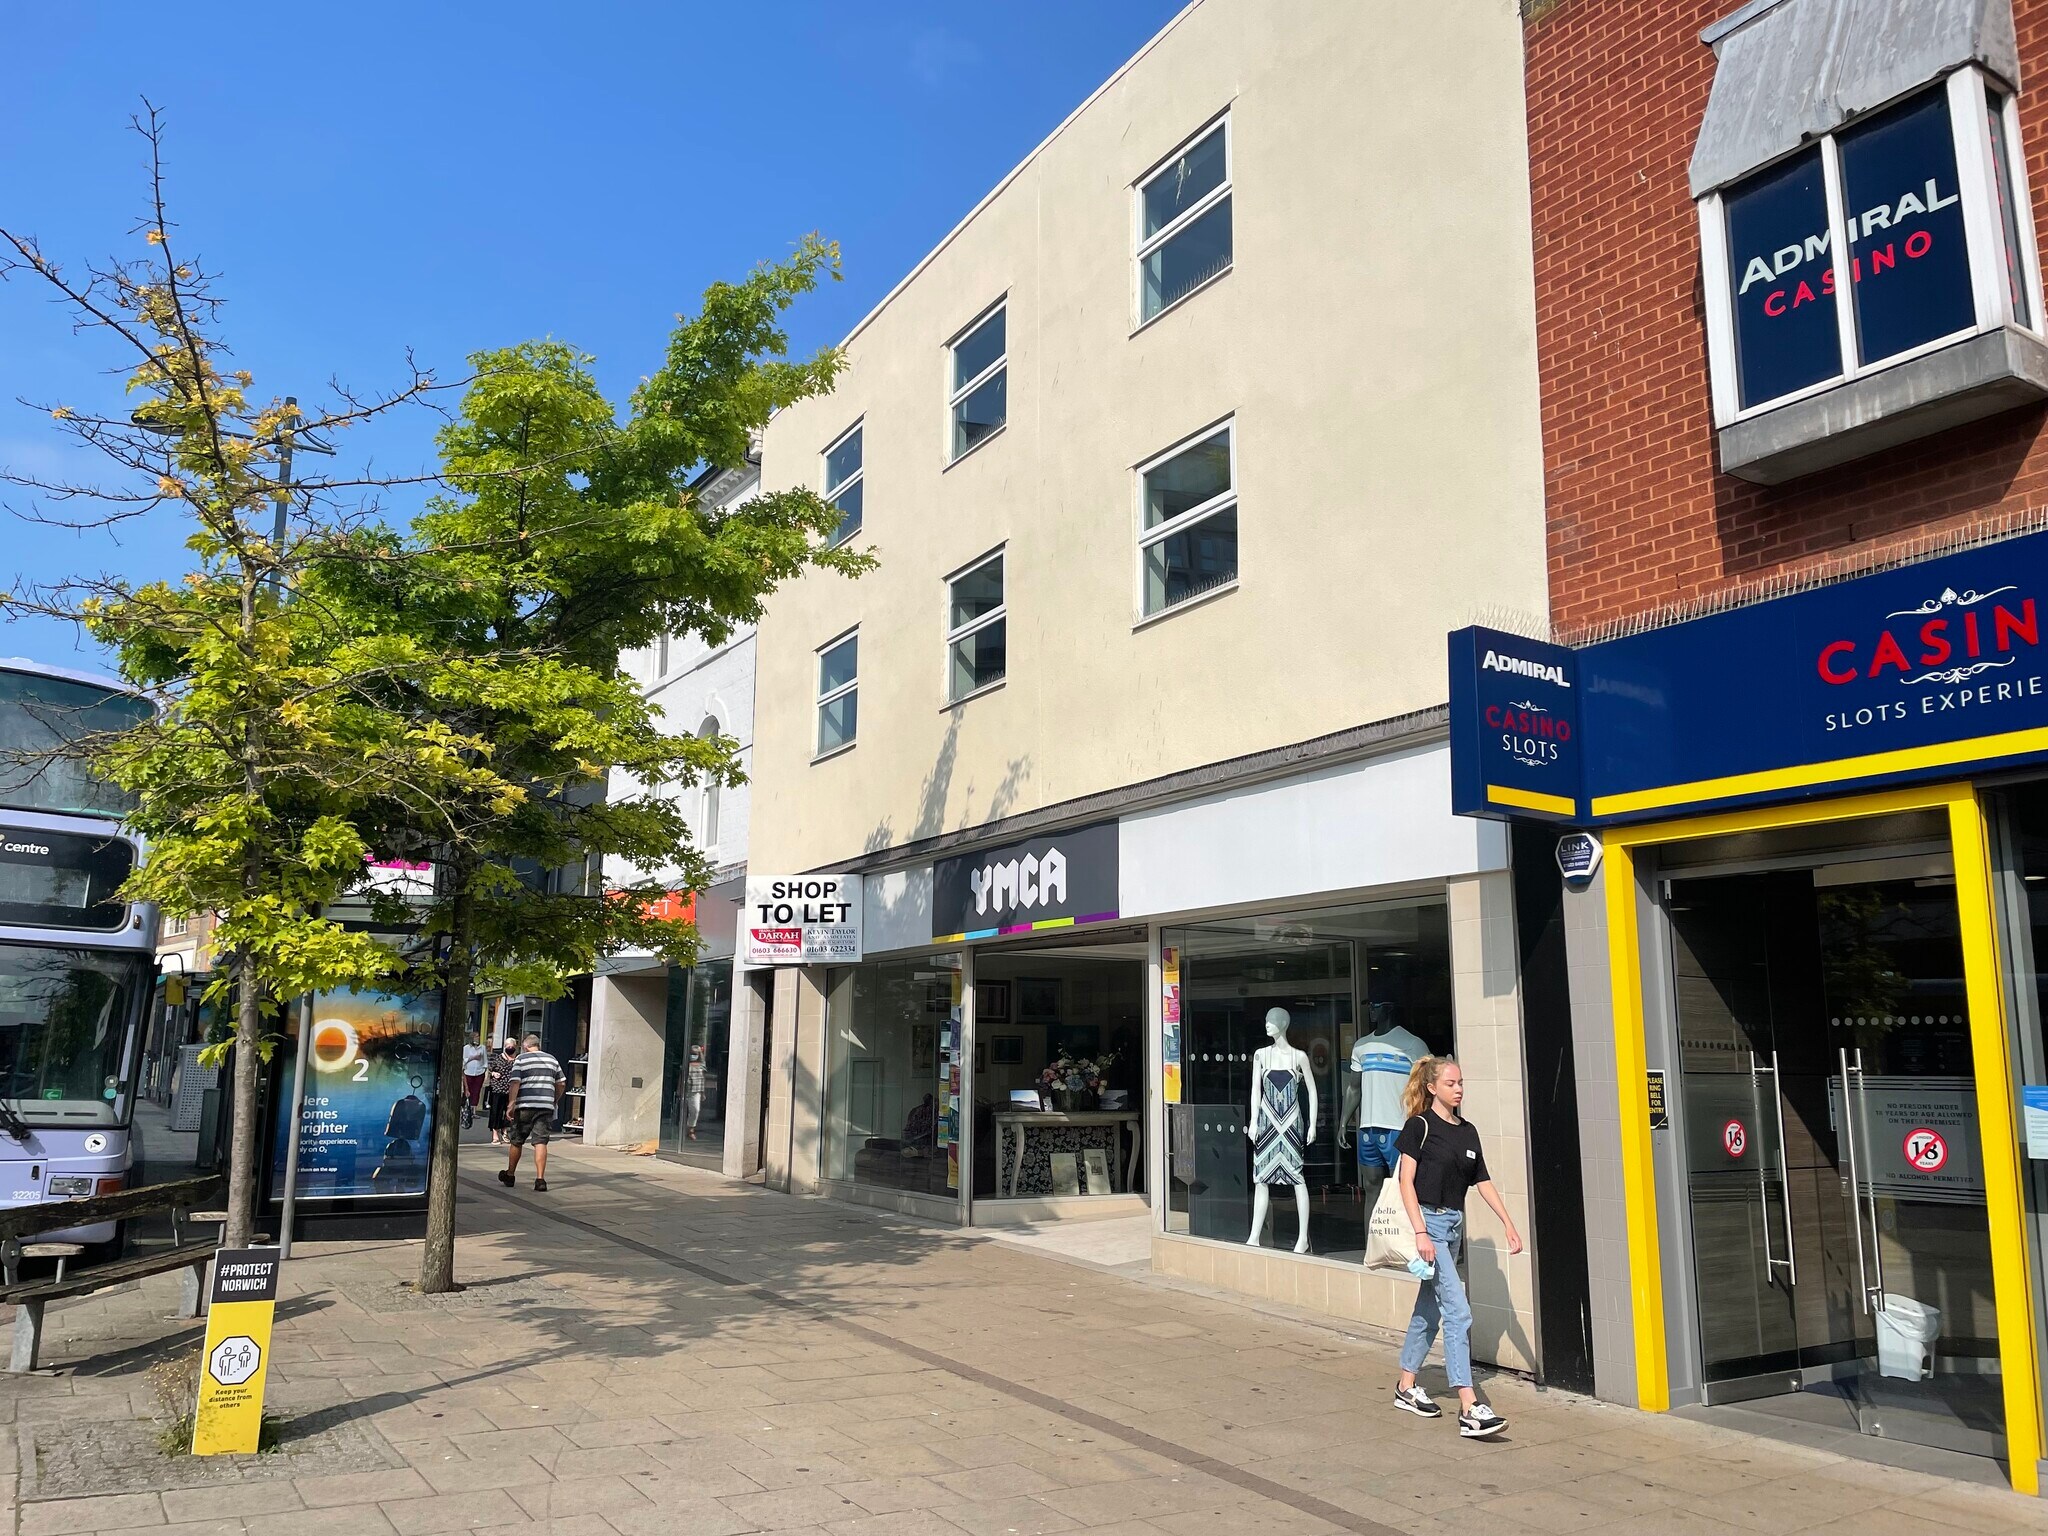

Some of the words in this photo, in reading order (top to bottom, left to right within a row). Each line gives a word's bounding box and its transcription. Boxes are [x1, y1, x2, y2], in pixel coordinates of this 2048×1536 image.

[1738, 178, 1958, 295] ADMIRAL
[1764, 231, 1932, 316] CASINO
[1817, 598, 2039, 685] CASIN
[1482, 650, 1570, 687] ADMIRAL
[1826, 702, 1906, 731] SLOTS
[1922, 676, 2043, 713] EXPERIE
[1486, 706, 1570, 742] CASINO
[1502, 735, 1558, 760] SLOTS
[5, 842, 49, 854] centre
[1561, 842, 1589, 852] LINK
[970, 846, 1067, 916] YMCA
[772, 882, 836, 899] SHOP
[758, 904, 793, 923] TO
[804, 903, 852, 923] LET
[758, 932, 799, 940] DARRAH
[302, 1108, 338, 1118] omes
[319, 1138, 358, 1146] experiences,
[1728, 1131, 1742, 1146] 18
[1912, 1141, 1938, 1160] 18
[1933, 1175, 1973, 1183] PERMITTED
[12, 1191, 40, 1200] 32205
[220, 1262, 273, 1277] #PROTECT
[222, 1278, 267, 1291] NORWICH
